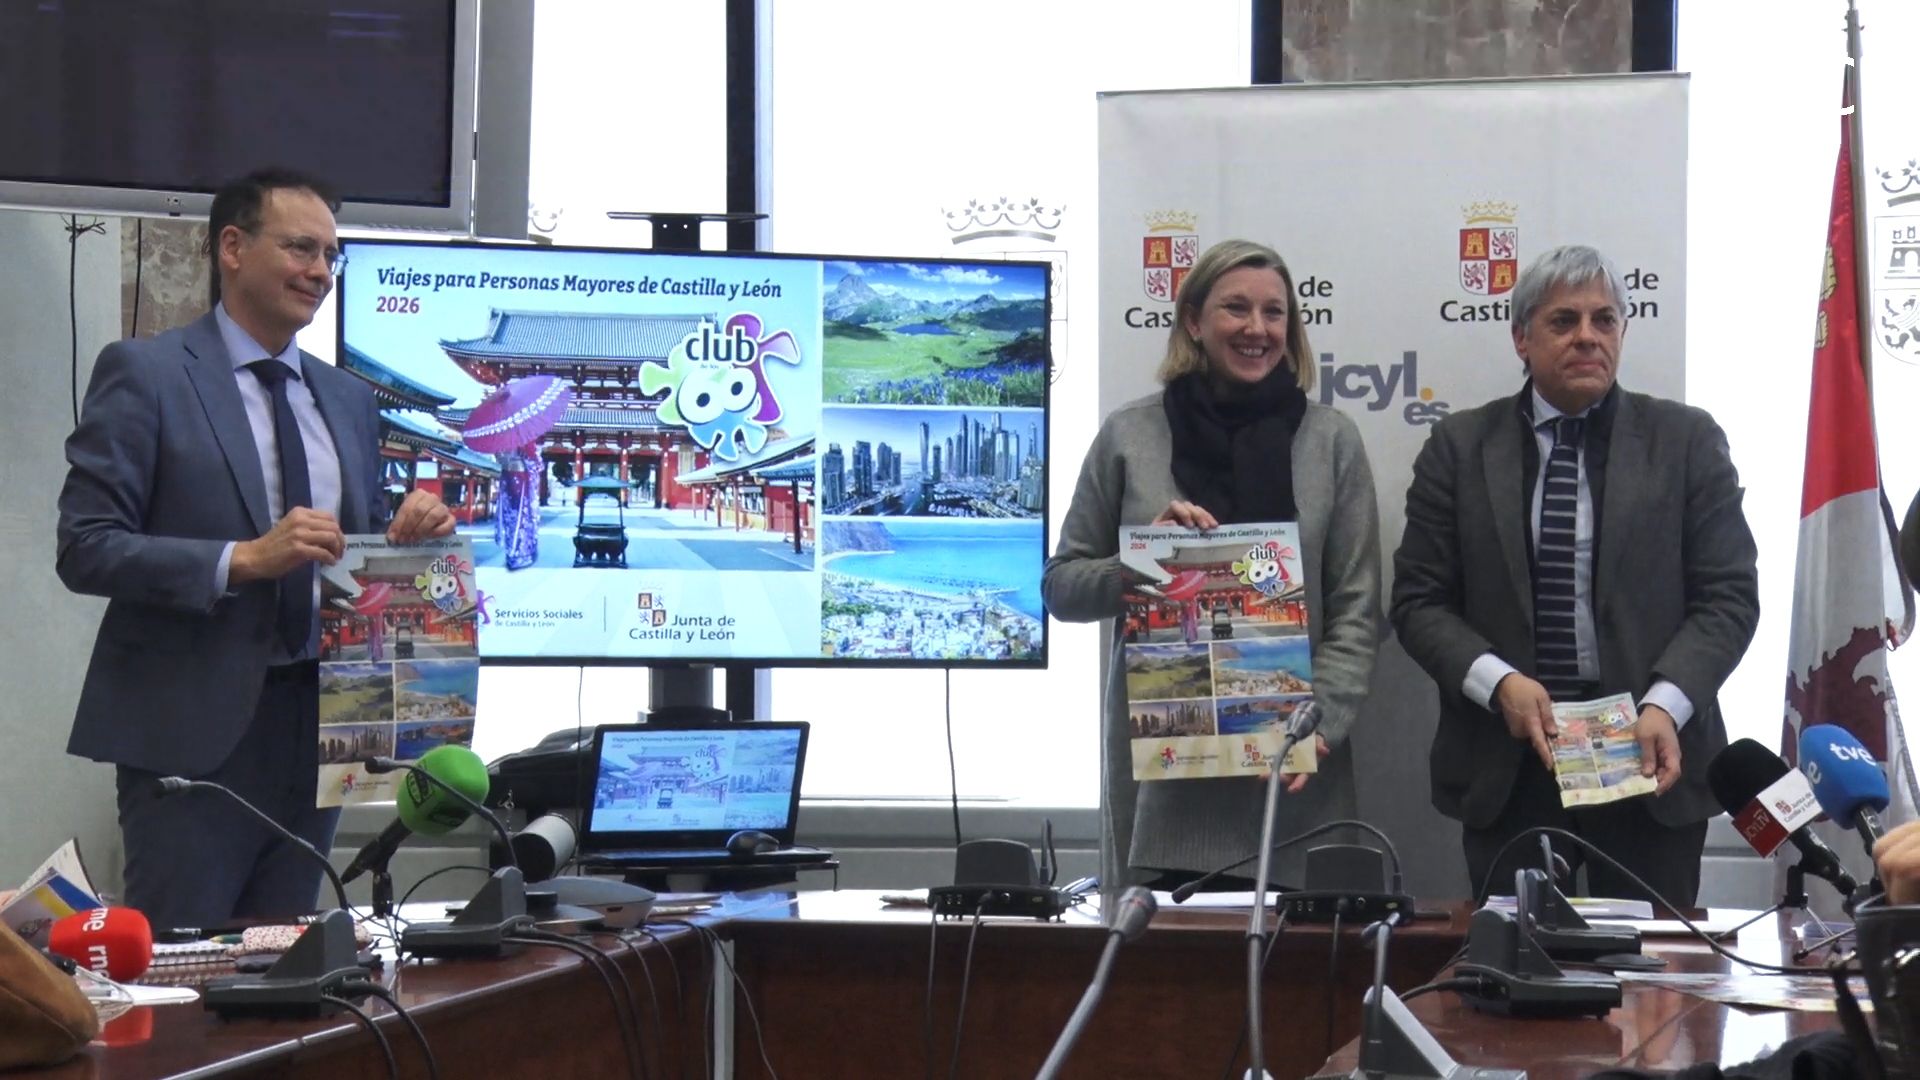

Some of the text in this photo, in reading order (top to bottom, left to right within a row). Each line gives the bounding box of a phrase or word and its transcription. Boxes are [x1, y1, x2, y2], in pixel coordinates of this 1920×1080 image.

[377, 267, 782, 301] Viajes para Personas Mayores de Castilla y León
[1299, 276, 1333, 297] de
[1625, 268, 1659, 290] de
[376, 296, 420, 313] 2026
[1440, 300, 1511, 322] Casti
[685, 328, 755, 362] club
[1250, 547, 1277, 560] club
[431, 559, 456, 575] club
[494, 609, 584, 619] Servicios Sociales
[671, 614, 736, 627] Junta de
[629, 628, 736, 643] Castilla y León
[1830, 743, 1877, 766] tve
